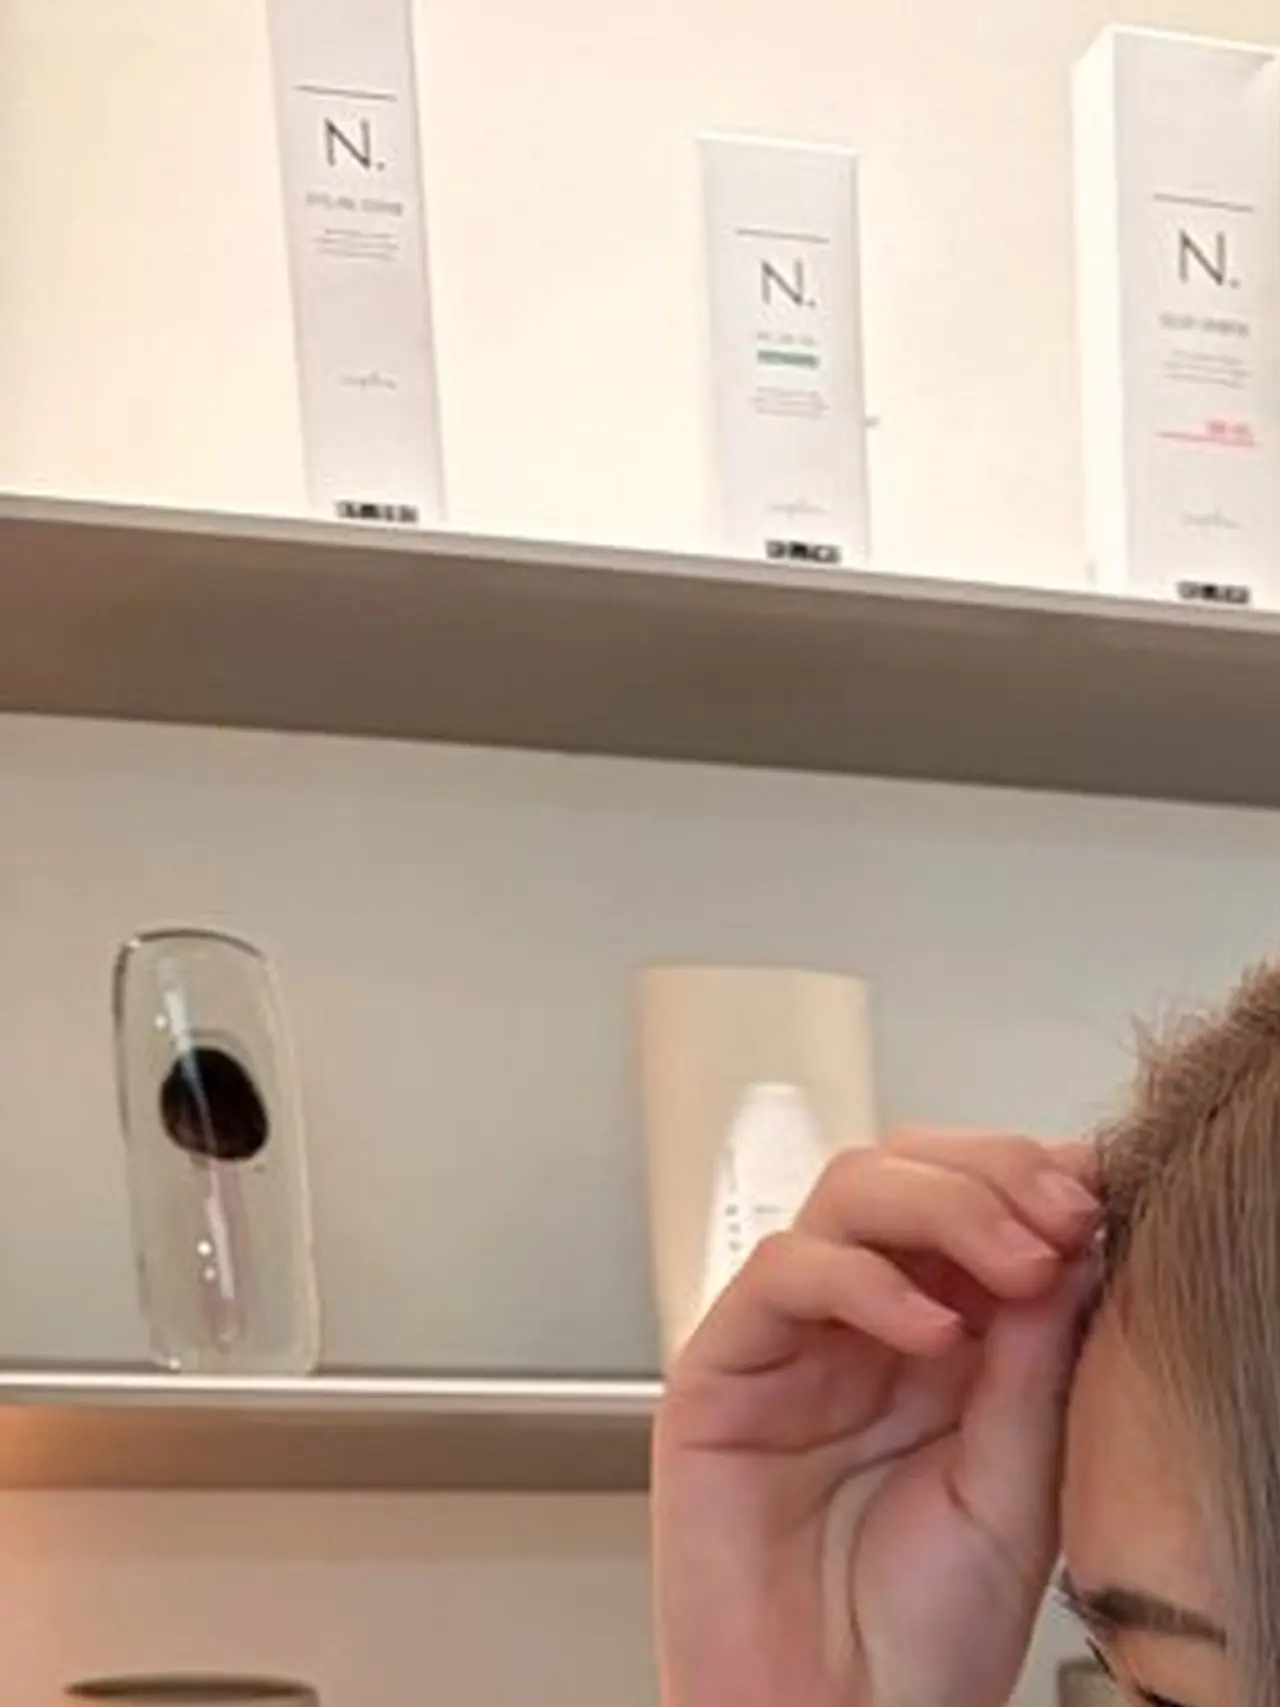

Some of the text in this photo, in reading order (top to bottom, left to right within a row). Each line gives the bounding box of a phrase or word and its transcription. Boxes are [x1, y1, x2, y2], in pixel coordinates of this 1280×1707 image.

[323, 116, 386, 172] N.
[761, 259, 817, 309] N.
[1177, 228, 1241, 288] N.
